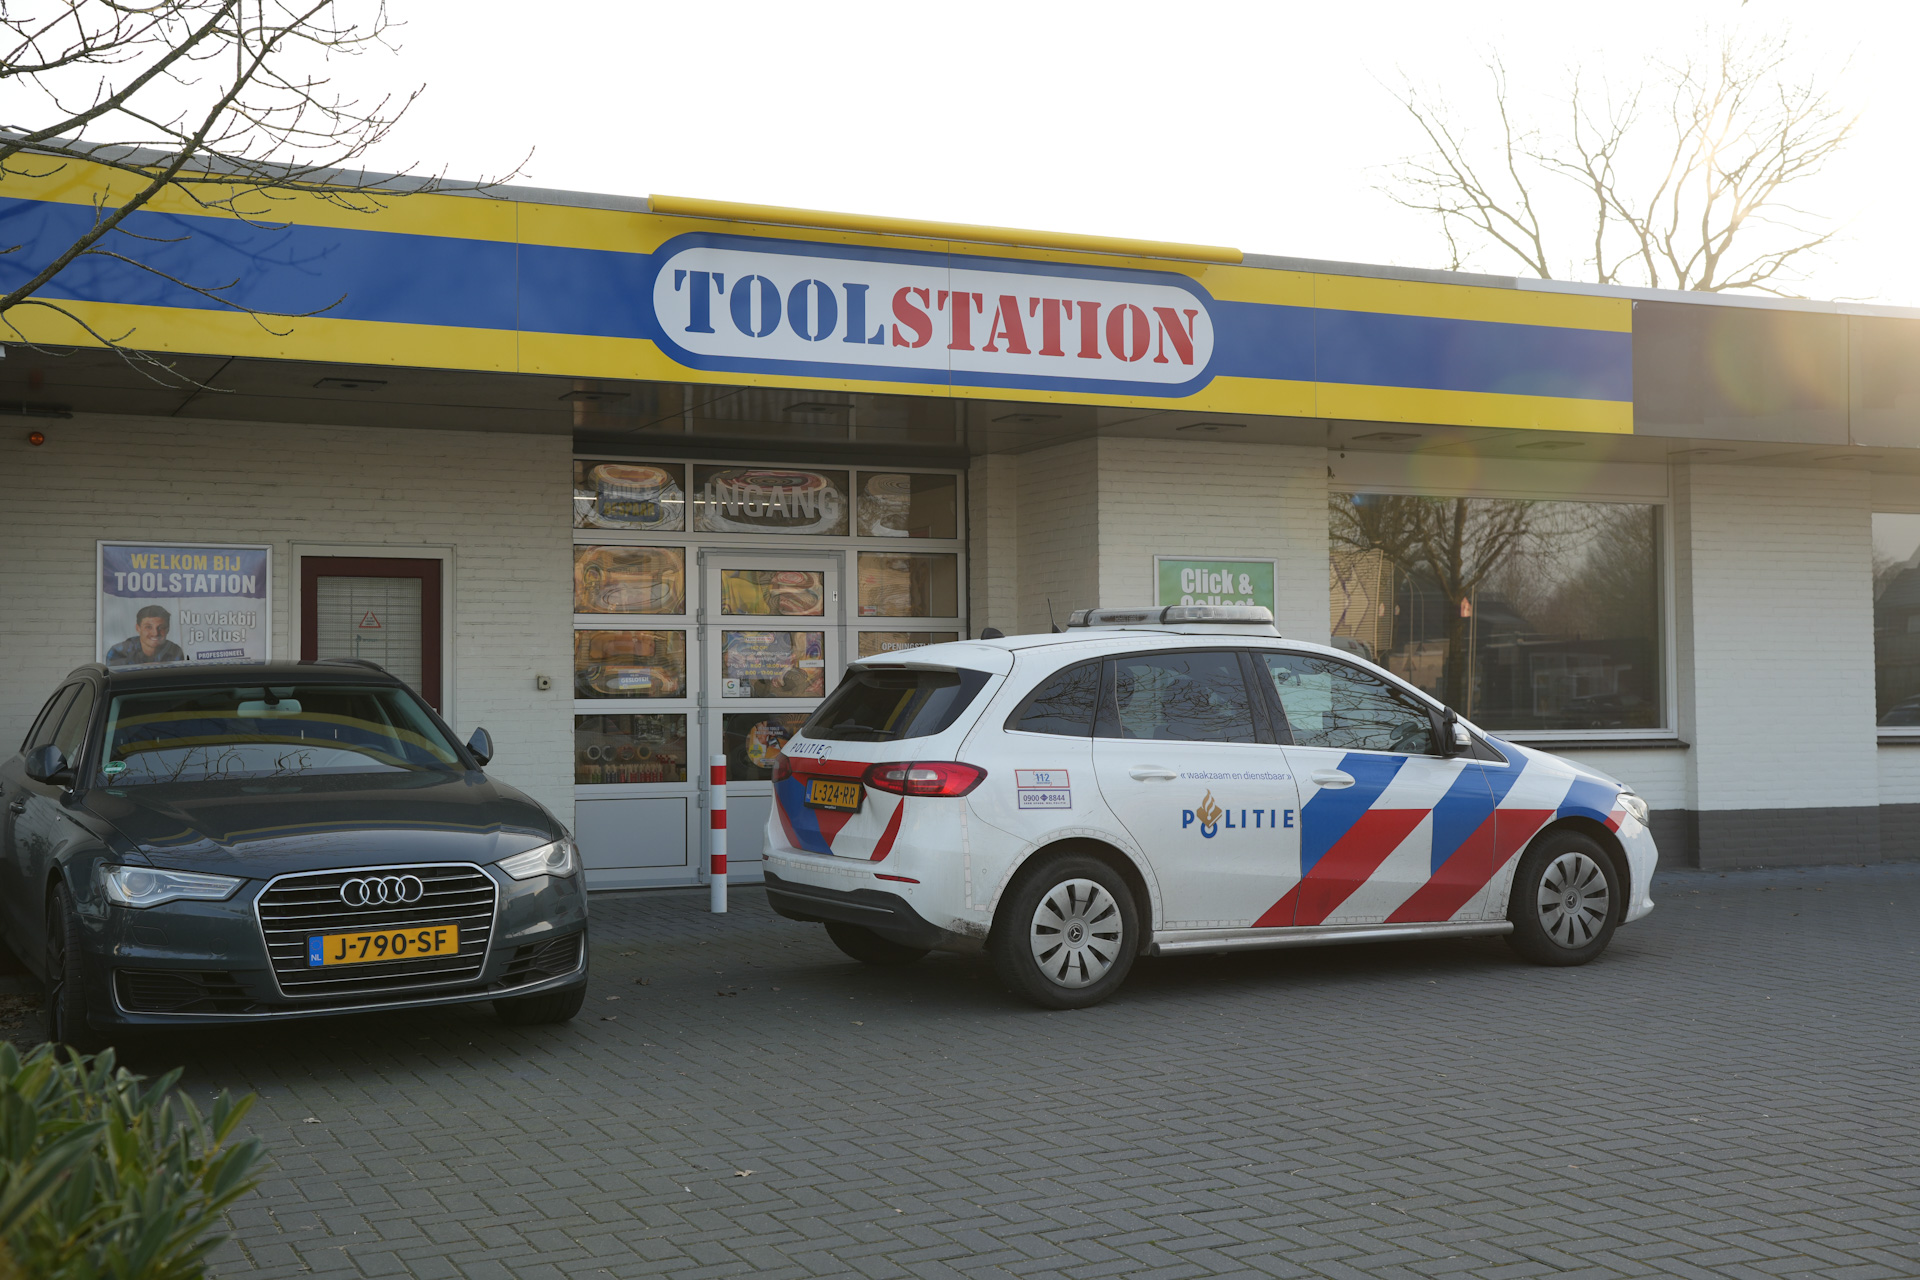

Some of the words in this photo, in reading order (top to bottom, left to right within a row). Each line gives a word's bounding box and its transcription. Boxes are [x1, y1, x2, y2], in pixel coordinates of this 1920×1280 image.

[674, 269, 1199, 366] TOOLSTATION
[603, 502, 655, 517] BESPAAR
[704, 482, 839, 520] INGANG
[131, 553, 207, 571] WELKOM
[213, 555, 241, 572] BIJ
[114, 571, 256, 594] TOOLSTATION
[1180, 568, 1234, 594] Click
[1238, 573, 1253, 595] &
[180, 610, 201, 625] Nu
[205, 610, 257, 629] vlakbij
[188, 627, 205, 645] je
[208, 628, 247, 643] klus!
[198, 649, 243, 660] PROFESSIONEEL
[790, 742, 825, 755] POLITIE
[1035, 773, 1051, 782] 112
[1187, 770, 1231, 780] waakzaam
[1232, 772, 1243, 780] en
[1243, 771, 1285, 781] dienstbaar
[813, 783, 856, 805] L-324-RR
[1023, 794, 1039, 802] 0900
[1048, 794, 1065, 802] 8844
[1182, 809, 1294, 839] POLITIE
[334, 929, 447, 960] J-790-SF
